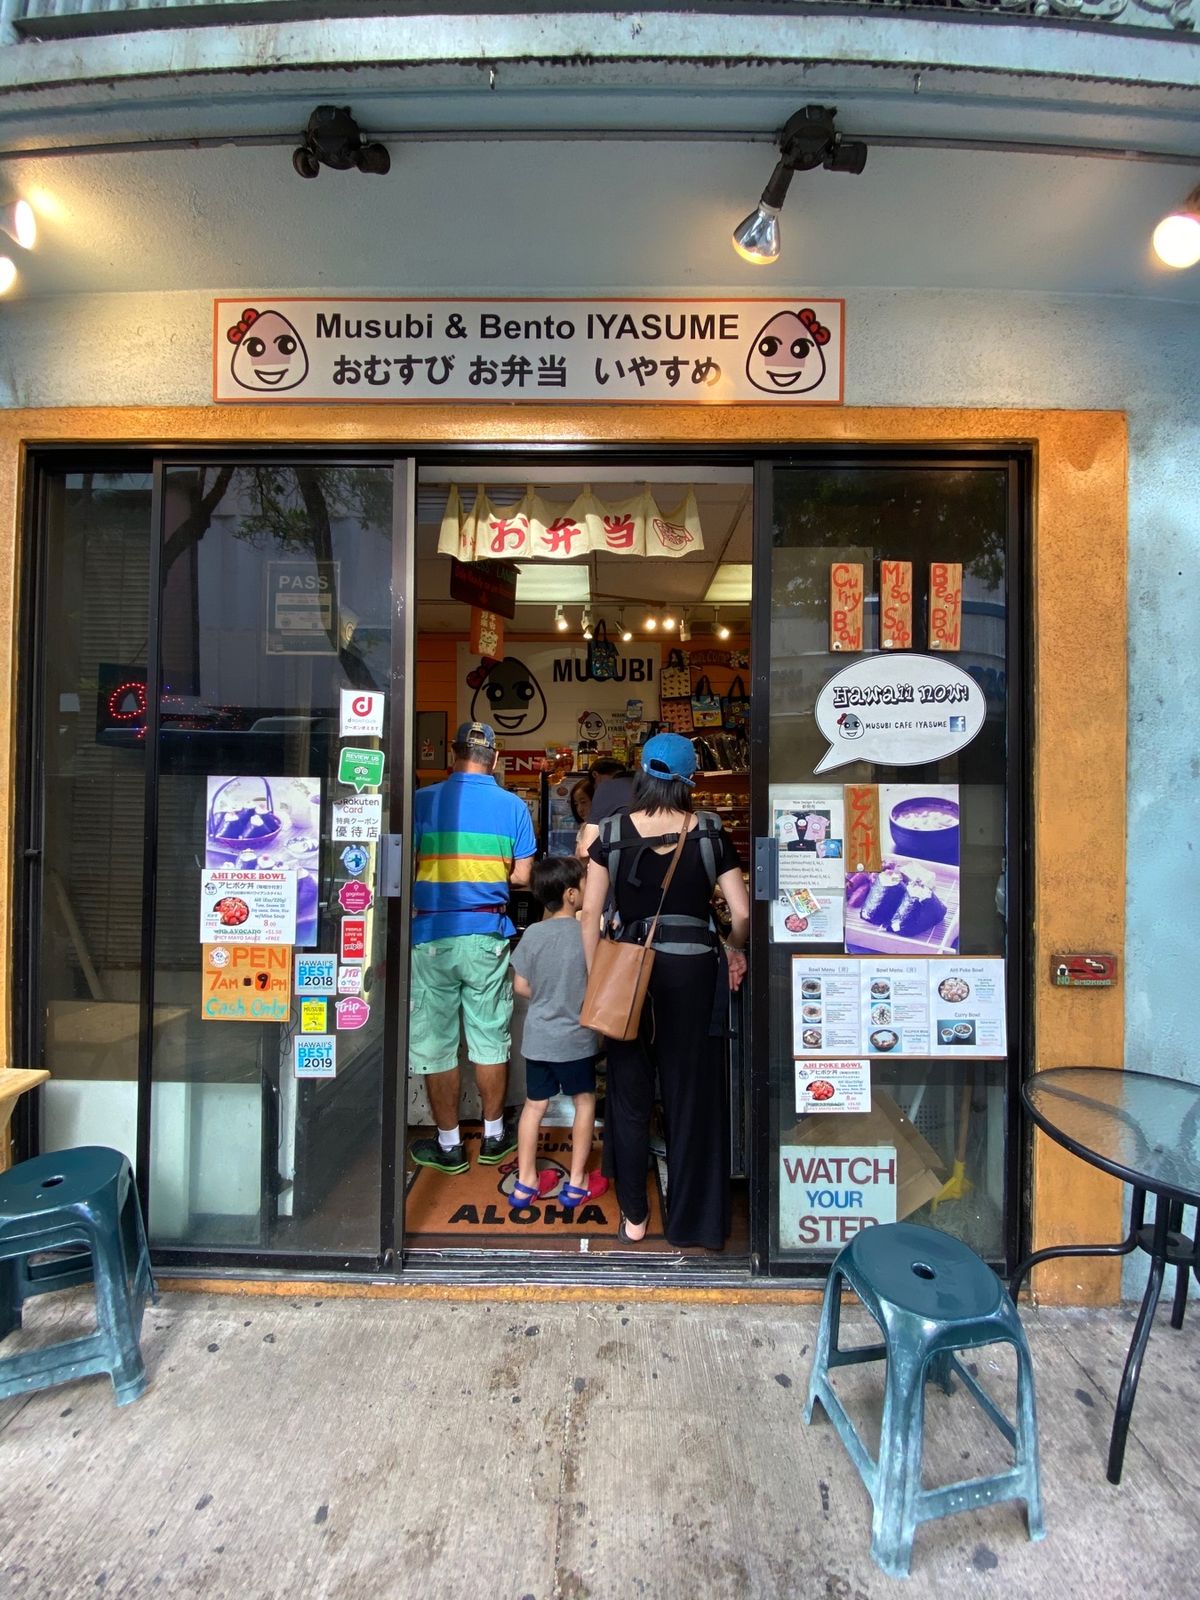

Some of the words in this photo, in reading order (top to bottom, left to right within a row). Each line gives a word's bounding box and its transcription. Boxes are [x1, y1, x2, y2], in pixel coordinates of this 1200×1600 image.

[316, 313, 433, 339] Musubi
[445, 313, 468, 339] &
[480, 314, 575, 339] Bento
[587, 314, 739, 340] IYASUME
[333, 354, 455, 385] おむすび
[469, 354, 566, 387] お弁当
[595, 356, 721, 387] いやすめ
[488, 513, 635, 555] お弁当
[278, 575, 329, 590] PASS
[882, 562, 911, 604] Miso
[933, 564, 961, 615] Beef
[834, 610, 861, 650] Bowl
[932, 608, 958, 647] Bowl
[553, 658, 653, 682] MUUBI
[833, 684, 914, 708] Hawaii
[895, 721, 912, 729] CAFE
[915, 720, 947, 728] IYASUME
[346, 752, 369, 761] REVIEW
[336, 826, 378, 838] 優待店
[210, 872, 228, 880] AHI
[231, 872, 256, 880] POKE
[298, 967, 333, 976] BEST
[305, 976, 333, 986] 2018
[1057, 976, 1070, 985] NO
[205, 997, 245, 1017] Cash
[251, 998, 287, 1018] Only
[298, 1048, 331, 1058] BEST
[304, 1058, 332, 1068] 2019
[783, 1157, 895, 1185] WATCH
[806, 1190, 863, 1208] YOUR
[448, 1204, 608, 1225] ALOHA
